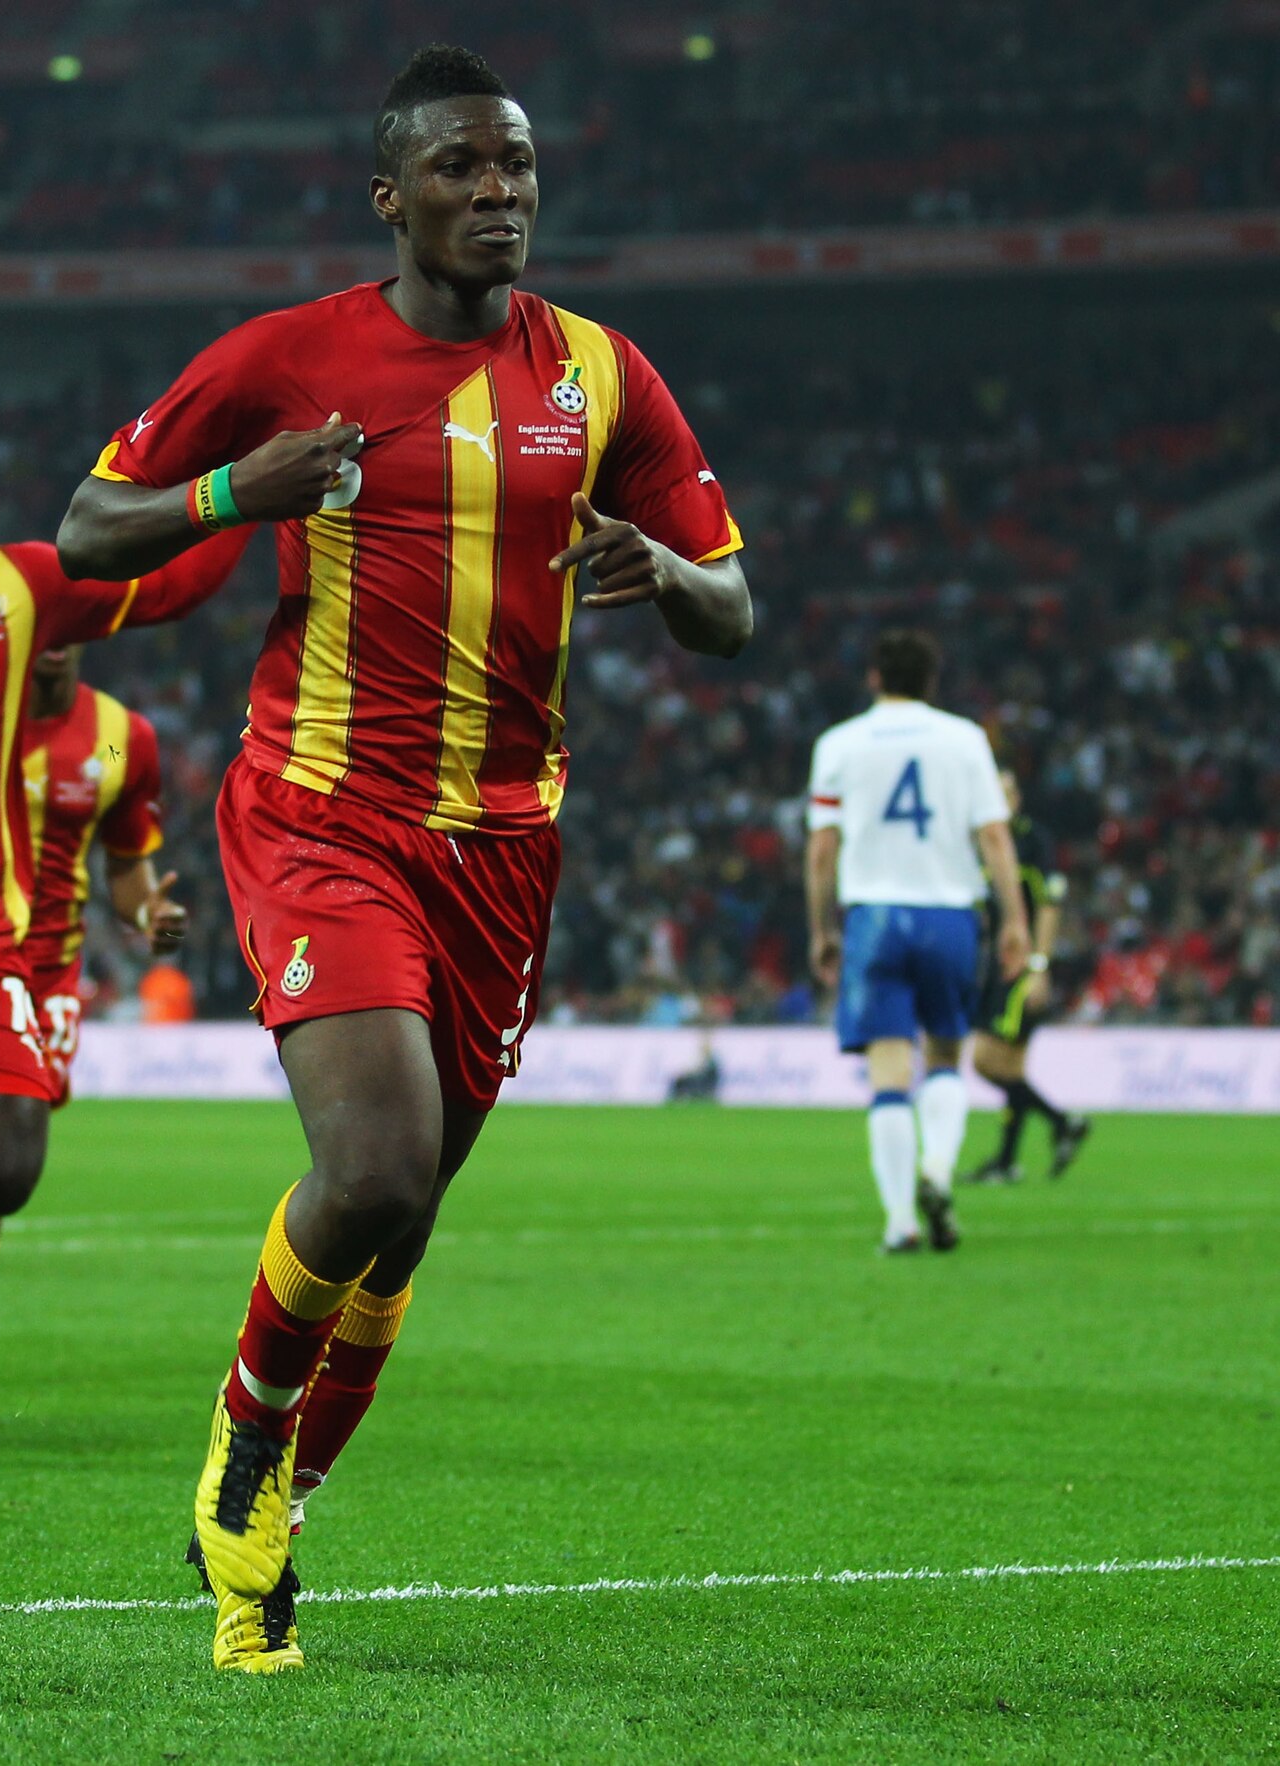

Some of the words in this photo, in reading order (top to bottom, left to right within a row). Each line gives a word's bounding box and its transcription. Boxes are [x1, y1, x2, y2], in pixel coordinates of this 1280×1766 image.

[518, 424, 549, 435] England
[560, 424, 582, 435] Ghana
[535, 435, 569, 446] Wembley
[520, 445, 545, 455] March
[546, 445, 566, 456] 29th,
[566, 447, 582, 457] 2011
[883, 755, 934, 841] 4
